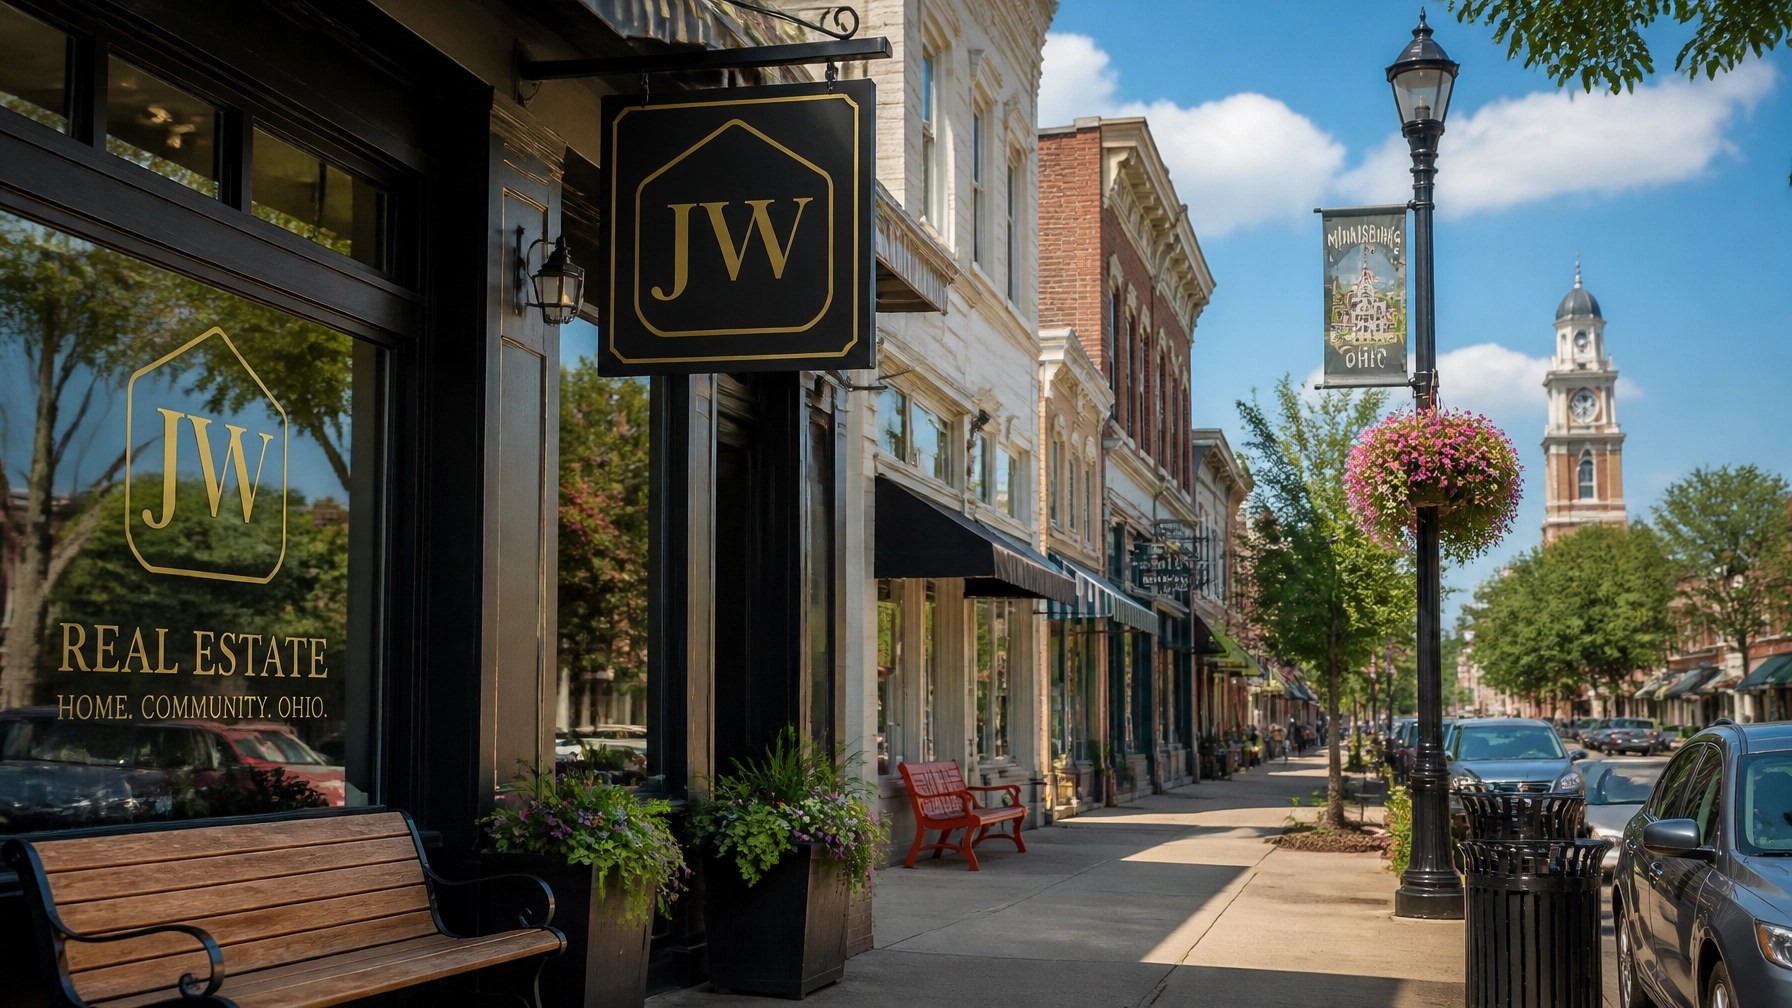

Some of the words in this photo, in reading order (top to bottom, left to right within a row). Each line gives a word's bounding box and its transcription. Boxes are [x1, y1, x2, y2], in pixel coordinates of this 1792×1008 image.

[651, 197, 814, 301] JW
[142, 407, 274, 530] JW
[58, 622, 179, 674] REAL
[193, 630, 329, 679] ESTATE
[57, 694, 133, 720] HOME.
[141, 694, 272, 719] COMMUNITY.
[278, 696, 328, 718] OHIO.
